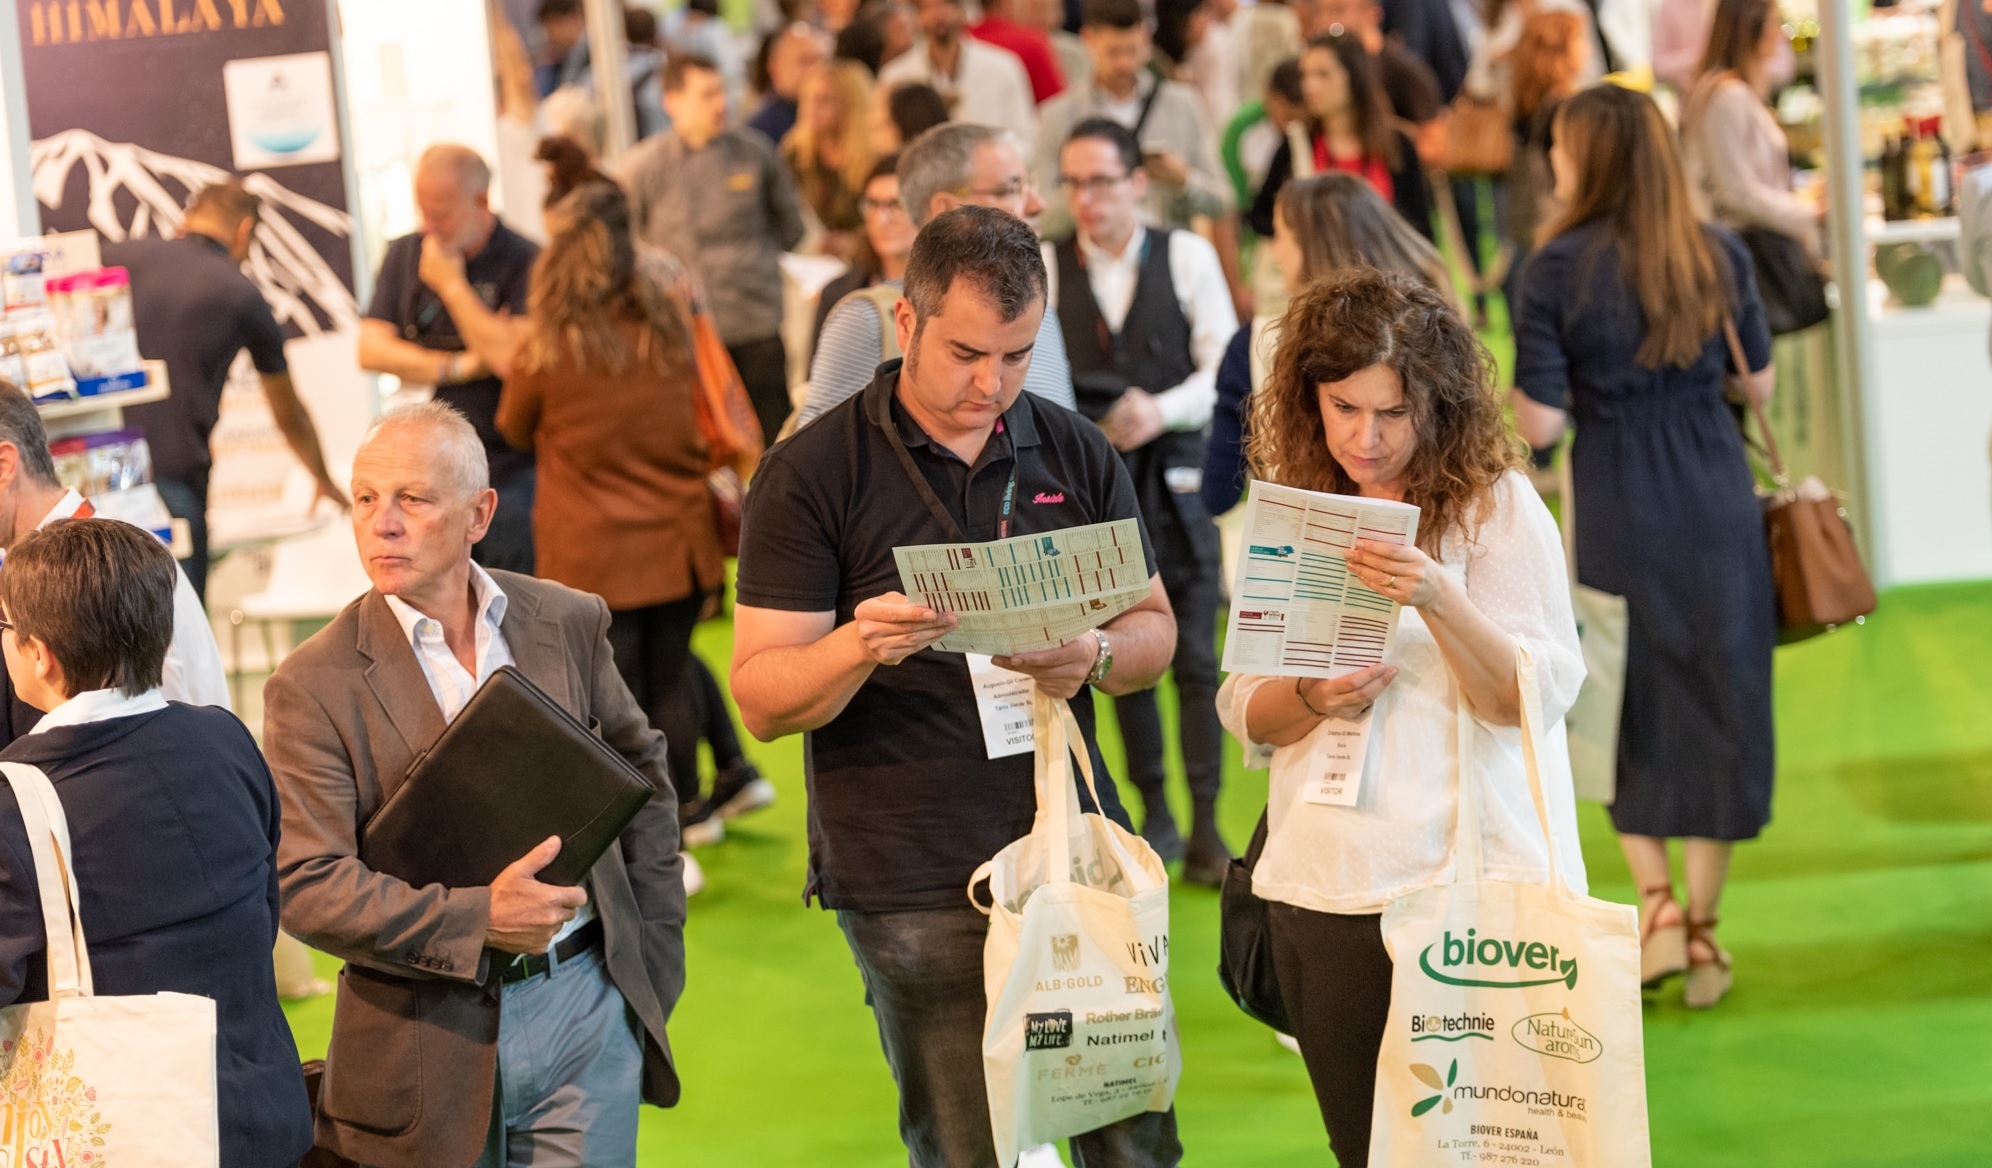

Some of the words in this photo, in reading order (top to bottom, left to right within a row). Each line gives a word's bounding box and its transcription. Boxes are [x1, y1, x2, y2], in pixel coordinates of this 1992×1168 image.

[31, 0, 286, 46] HIMALAYA
[1320, 787, 1343, 795] VISITOR
[1443, 928, 1559, 971] biover
[1086, 1011, 1132, 1024] Rother
[1411, 1012, 1495, 1032] Biotechnie
[1087, 1030, 1154, 1046] Natimel
[1528, 1107, 1555, 1117] health
[1557, 1109, 1564, 1117] &
[1470, 1125, 1502, 1136] BIOVER
[1505, 1128, 1539, 1140] ESPAÑA
[1438, 1139, 1449, 1149] La
[1483, 1140, 1490, 1148] 6
[1499, 1142, 1530, 1153] 24002
[1540, 1145, 1564, 1156] León
[1479, 1152, 1498, 1162] 987
[1500, 1155, 1518, 1164] 276
[1520, 1157, 1540, 1167] 220
